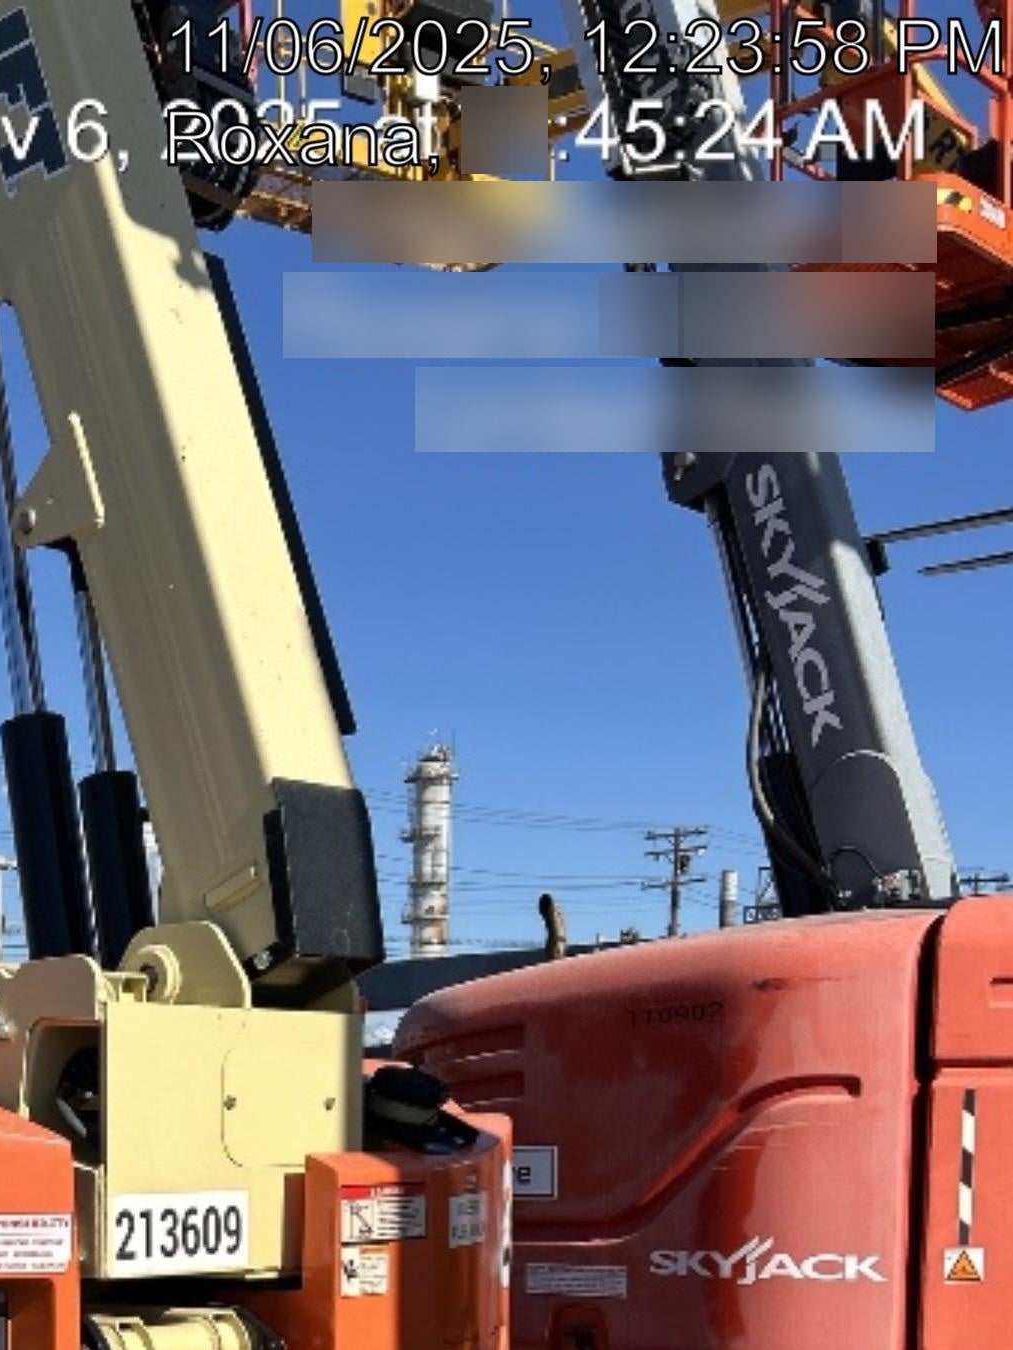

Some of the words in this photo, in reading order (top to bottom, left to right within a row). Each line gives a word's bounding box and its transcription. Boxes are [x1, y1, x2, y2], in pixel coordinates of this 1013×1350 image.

[745, 463, 843, 748] SKYJACK
[115, 1205, 243, 1260] 213609
[649, 1235, 888, 1285] SKYJACK
